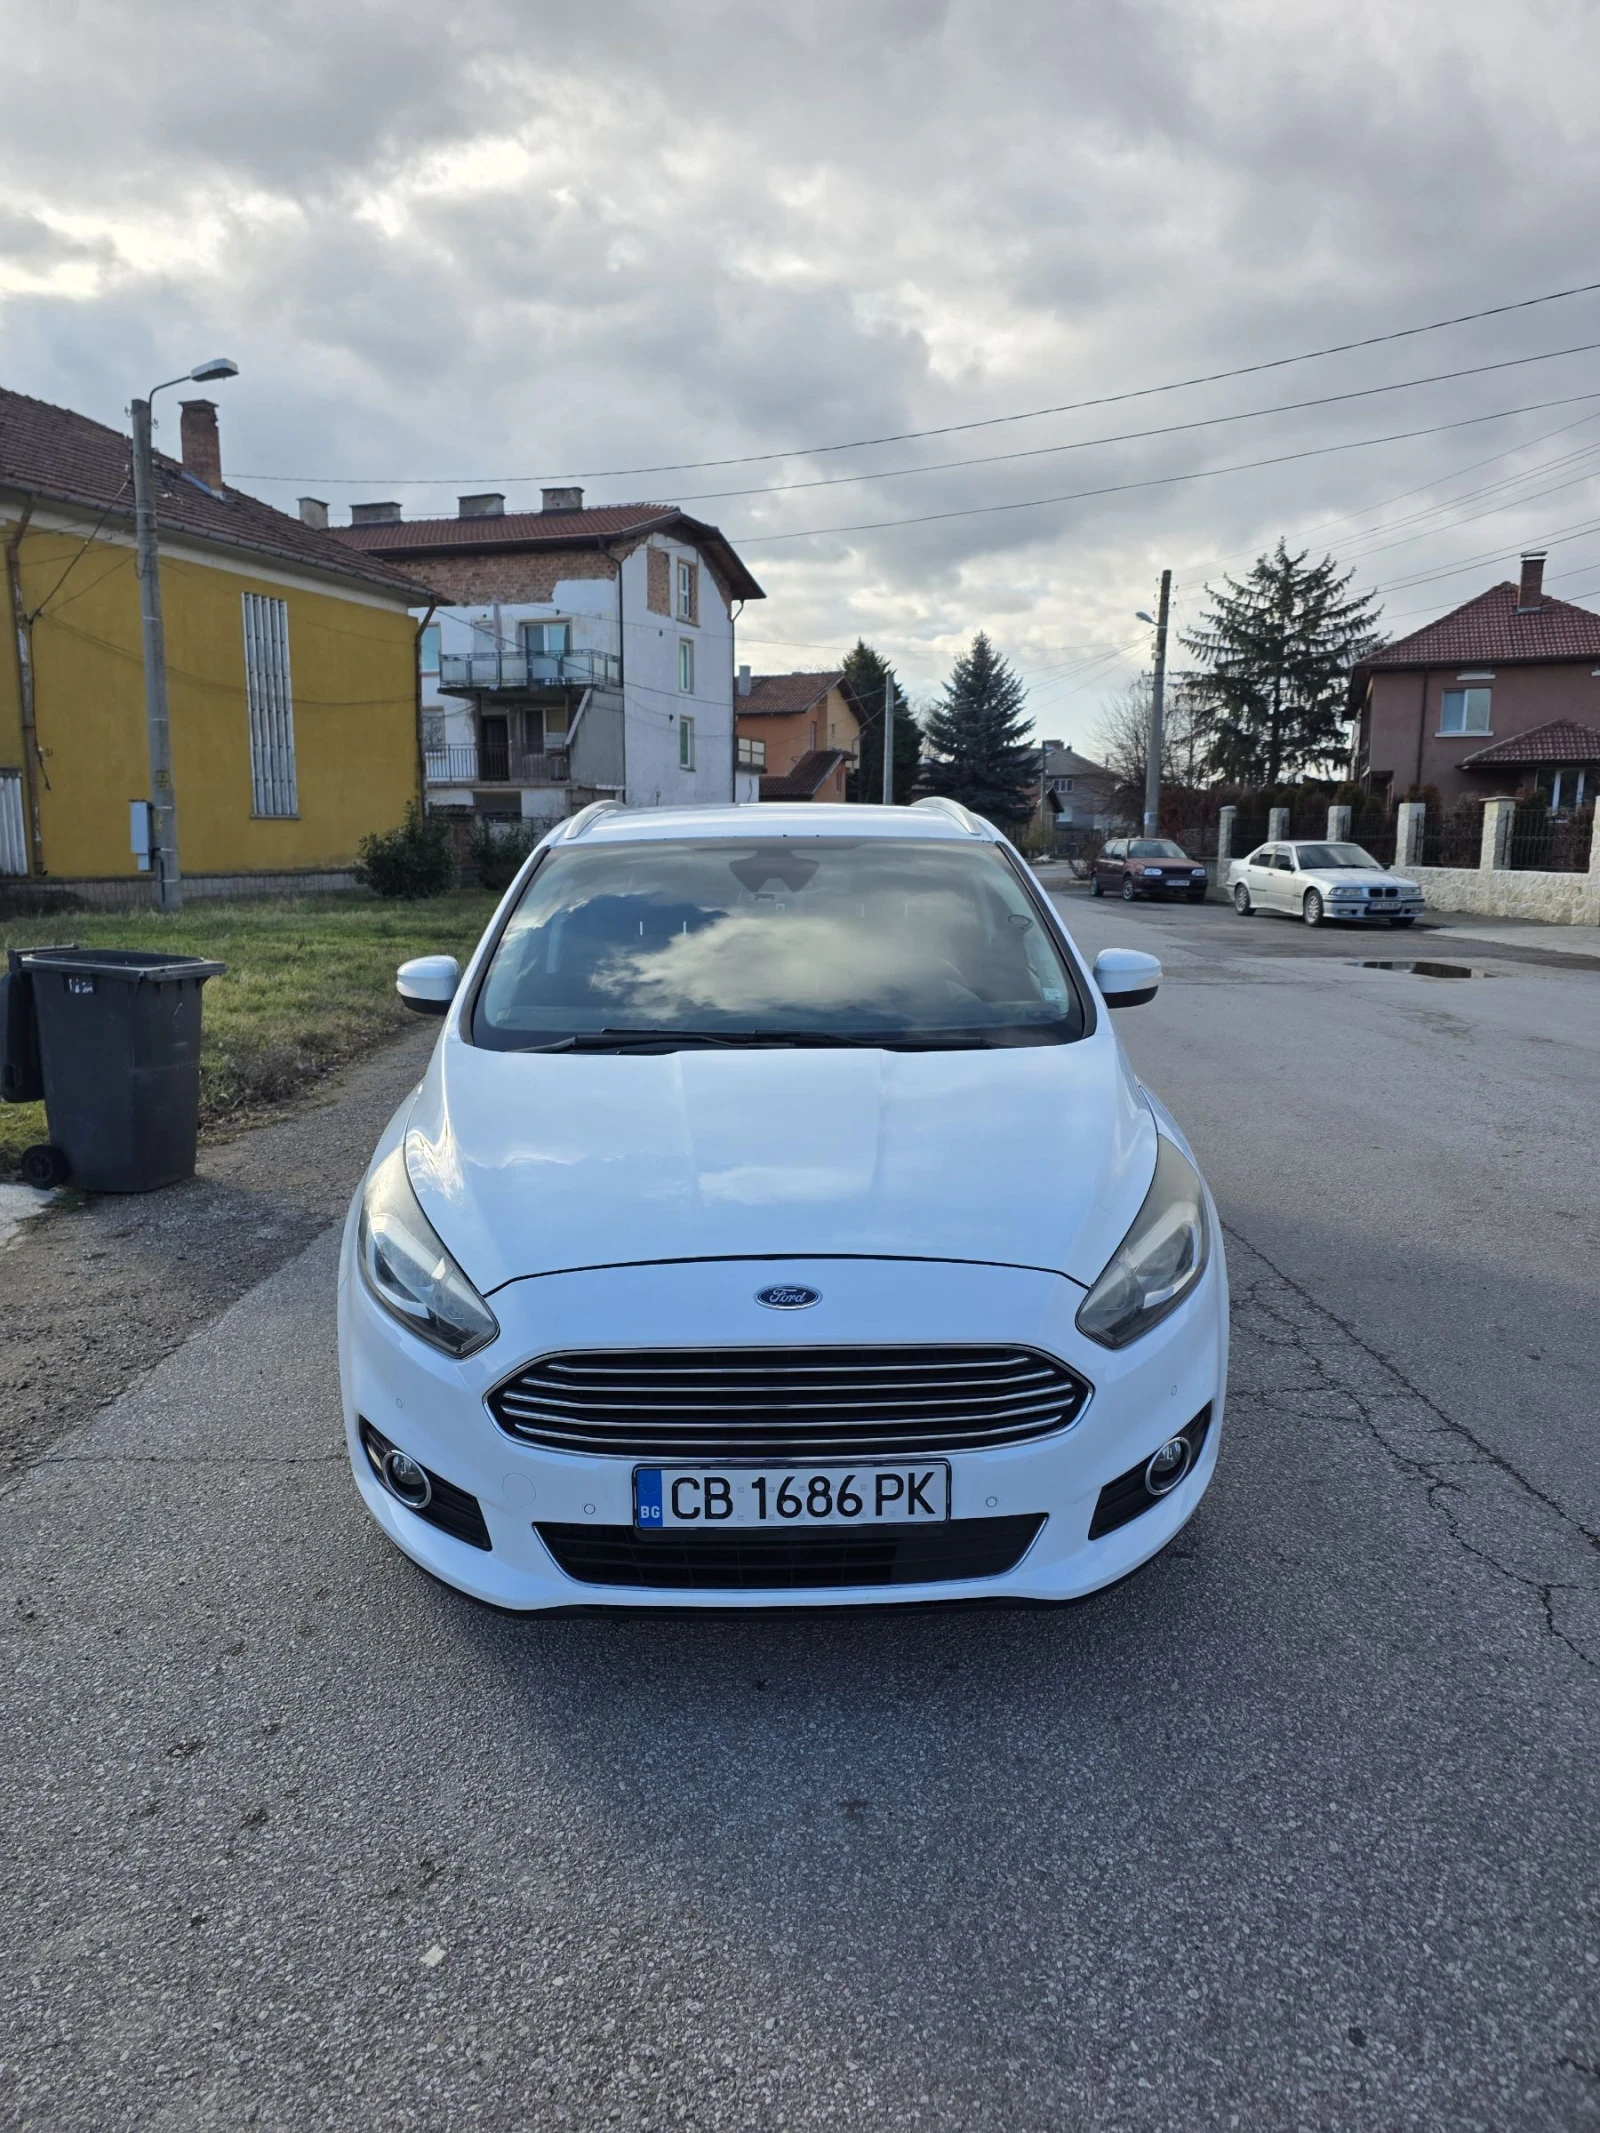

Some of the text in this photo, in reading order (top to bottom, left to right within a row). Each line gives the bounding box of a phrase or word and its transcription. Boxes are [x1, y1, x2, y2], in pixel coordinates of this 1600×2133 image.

[769, 1288, 807, 1303] Ford
[671, 1471, 936, 1520] CB 1686 PK
[640, 1505, 661, 1519] BG
